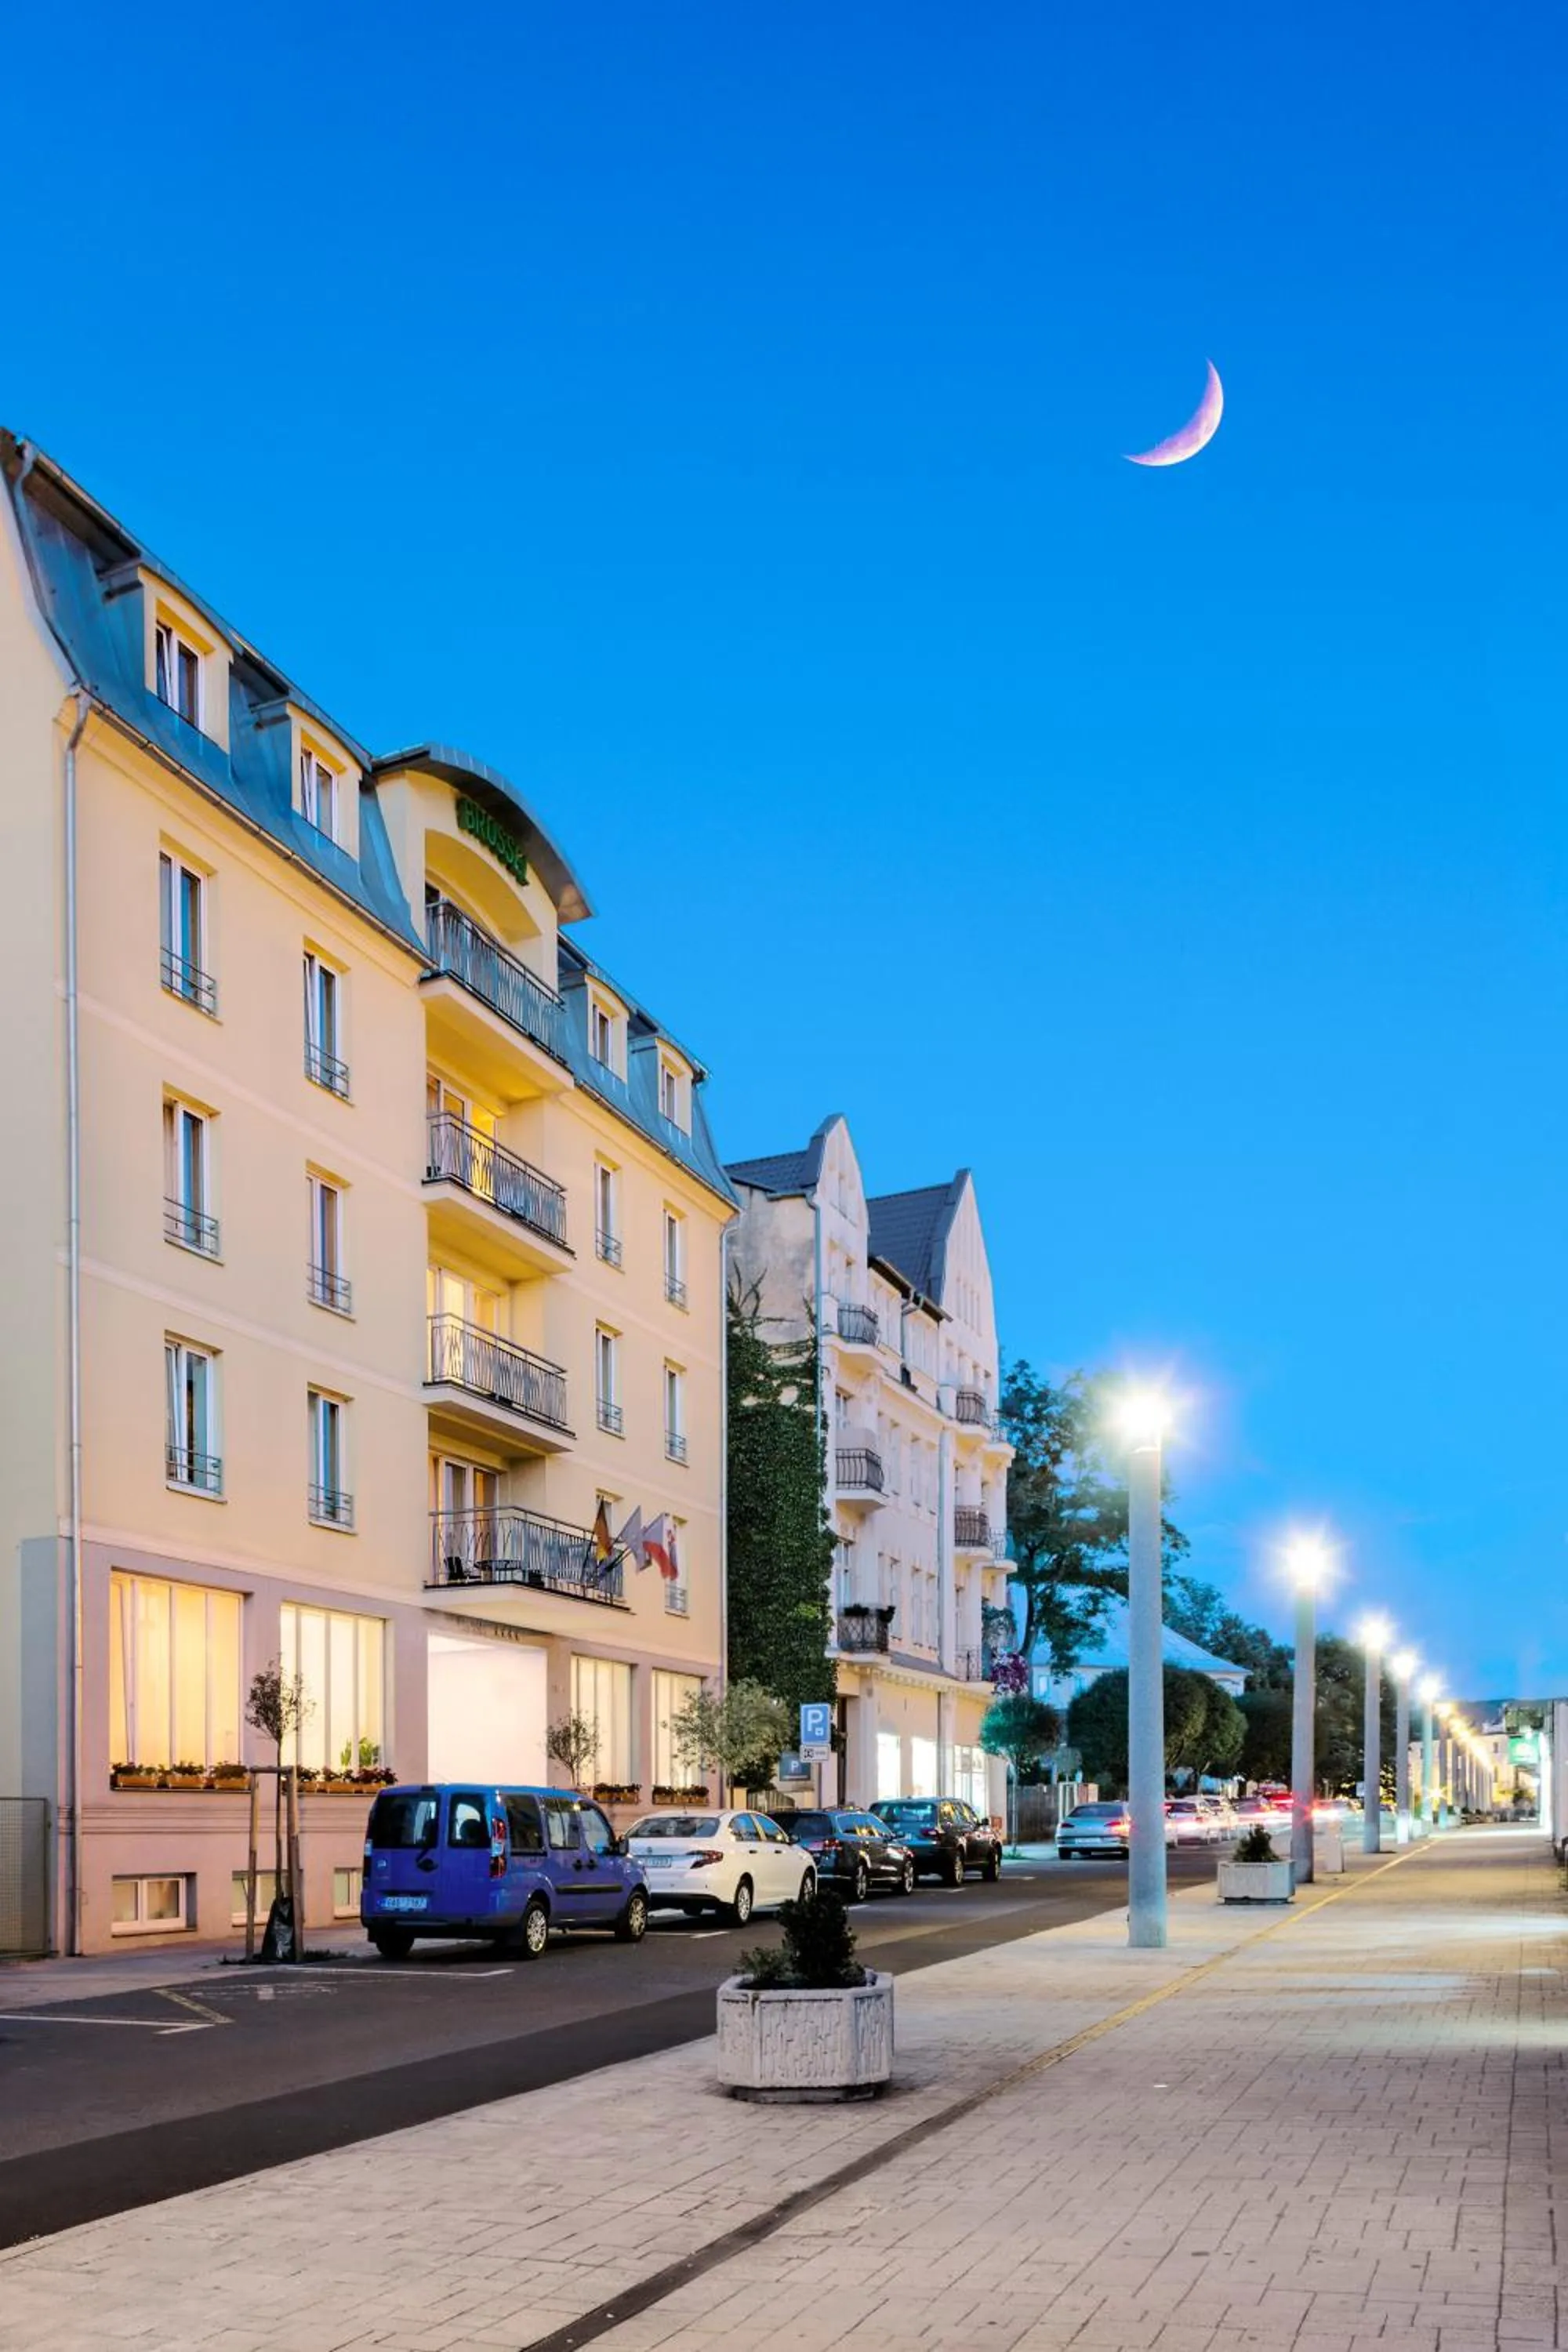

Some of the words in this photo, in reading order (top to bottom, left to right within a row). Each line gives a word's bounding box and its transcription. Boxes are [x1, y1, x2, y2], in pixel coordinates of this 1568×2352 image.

[458, 795, 529, 886] BRUSSE
[808, 1710, 823, 1731] P
[791, 1761, 799, 1773] P
